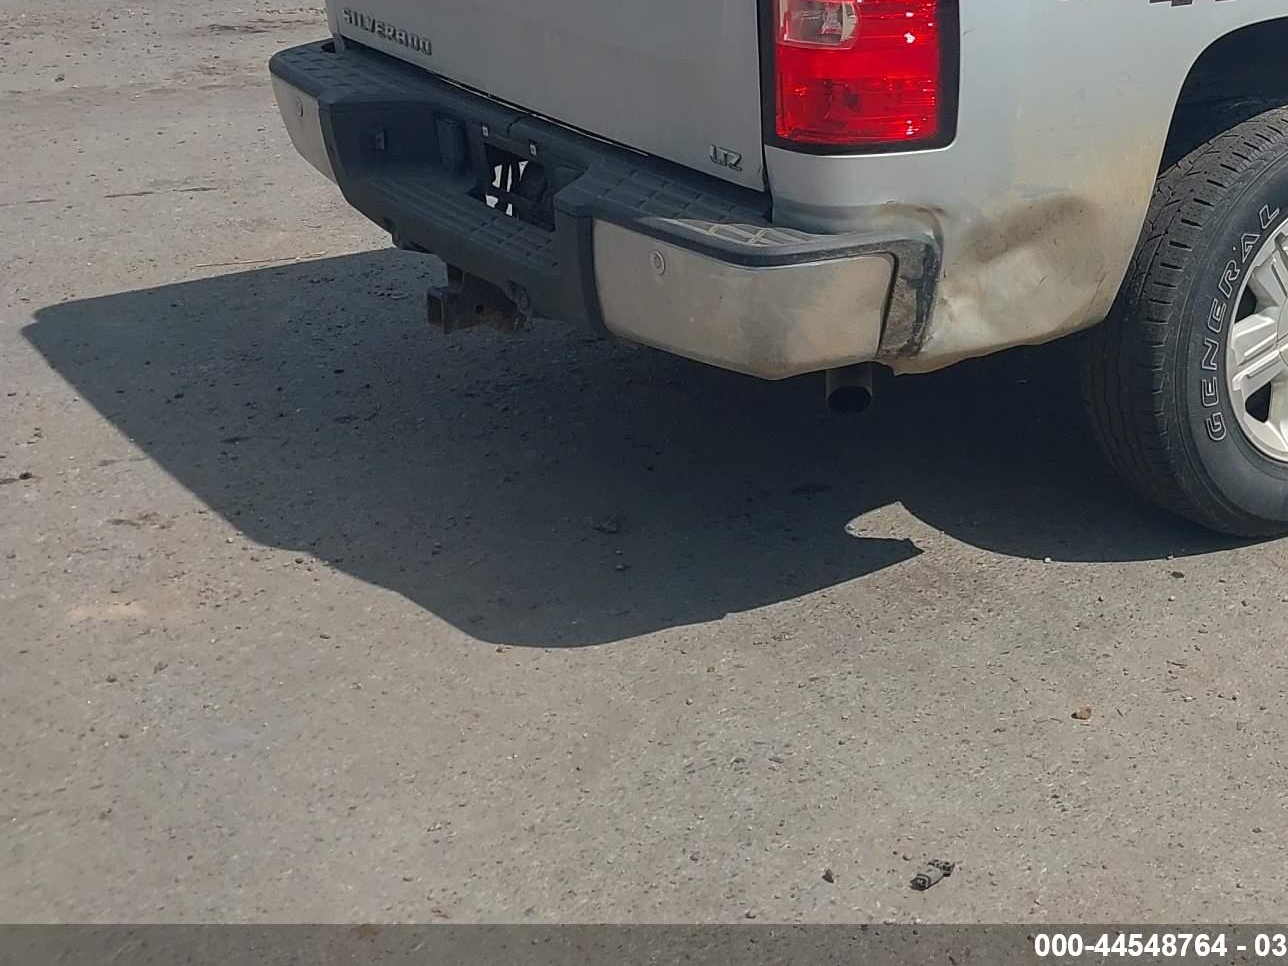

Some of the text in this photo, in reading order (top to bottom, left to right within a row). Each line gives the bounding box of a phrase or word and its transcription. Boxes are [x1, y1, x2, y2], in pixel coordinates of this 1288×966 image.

[342, 7, 432, 56] SILVERADO
[709, 144, 743, 172] LTZ
[1200, 203, 1280, 442] GENERAL
